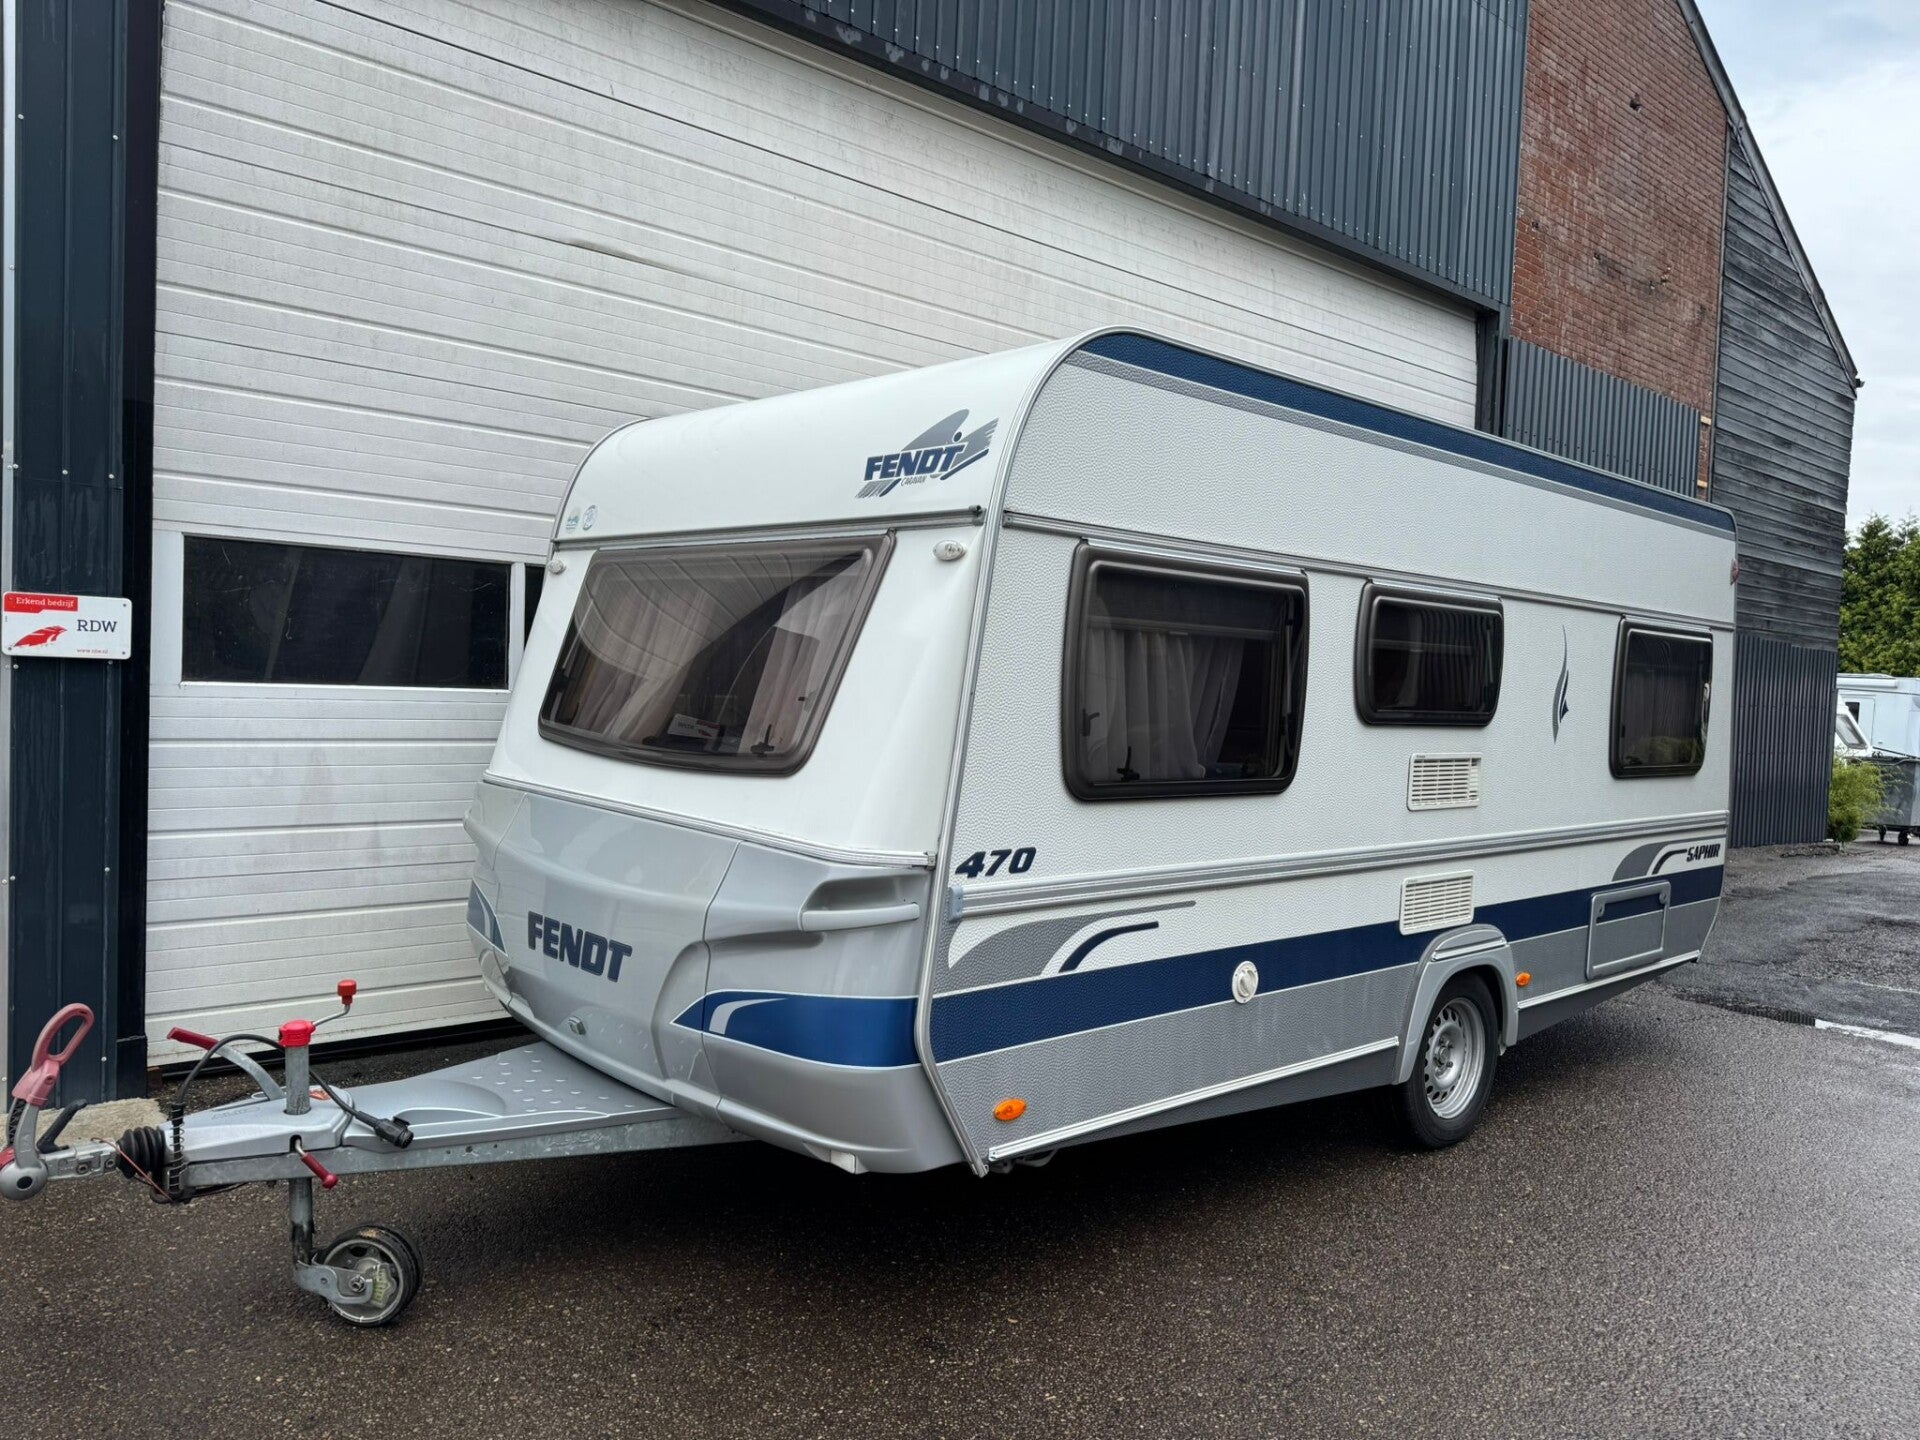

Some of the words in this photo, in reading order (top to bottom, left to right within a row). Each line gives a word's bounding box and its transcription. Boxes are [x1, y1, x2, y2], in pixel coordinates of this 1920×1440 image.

[864, 444, 966, 481] FENDT
[16, 597, 46, 606] Erkend
[47, 598, 75, 608] bedrijf
[77, 619, 118, 633] RDW
[955, 847, 1037, 879] 470
[1686, 843, 1721, 862] SAPHIR
[528, 911, 633, 983] FENDT
